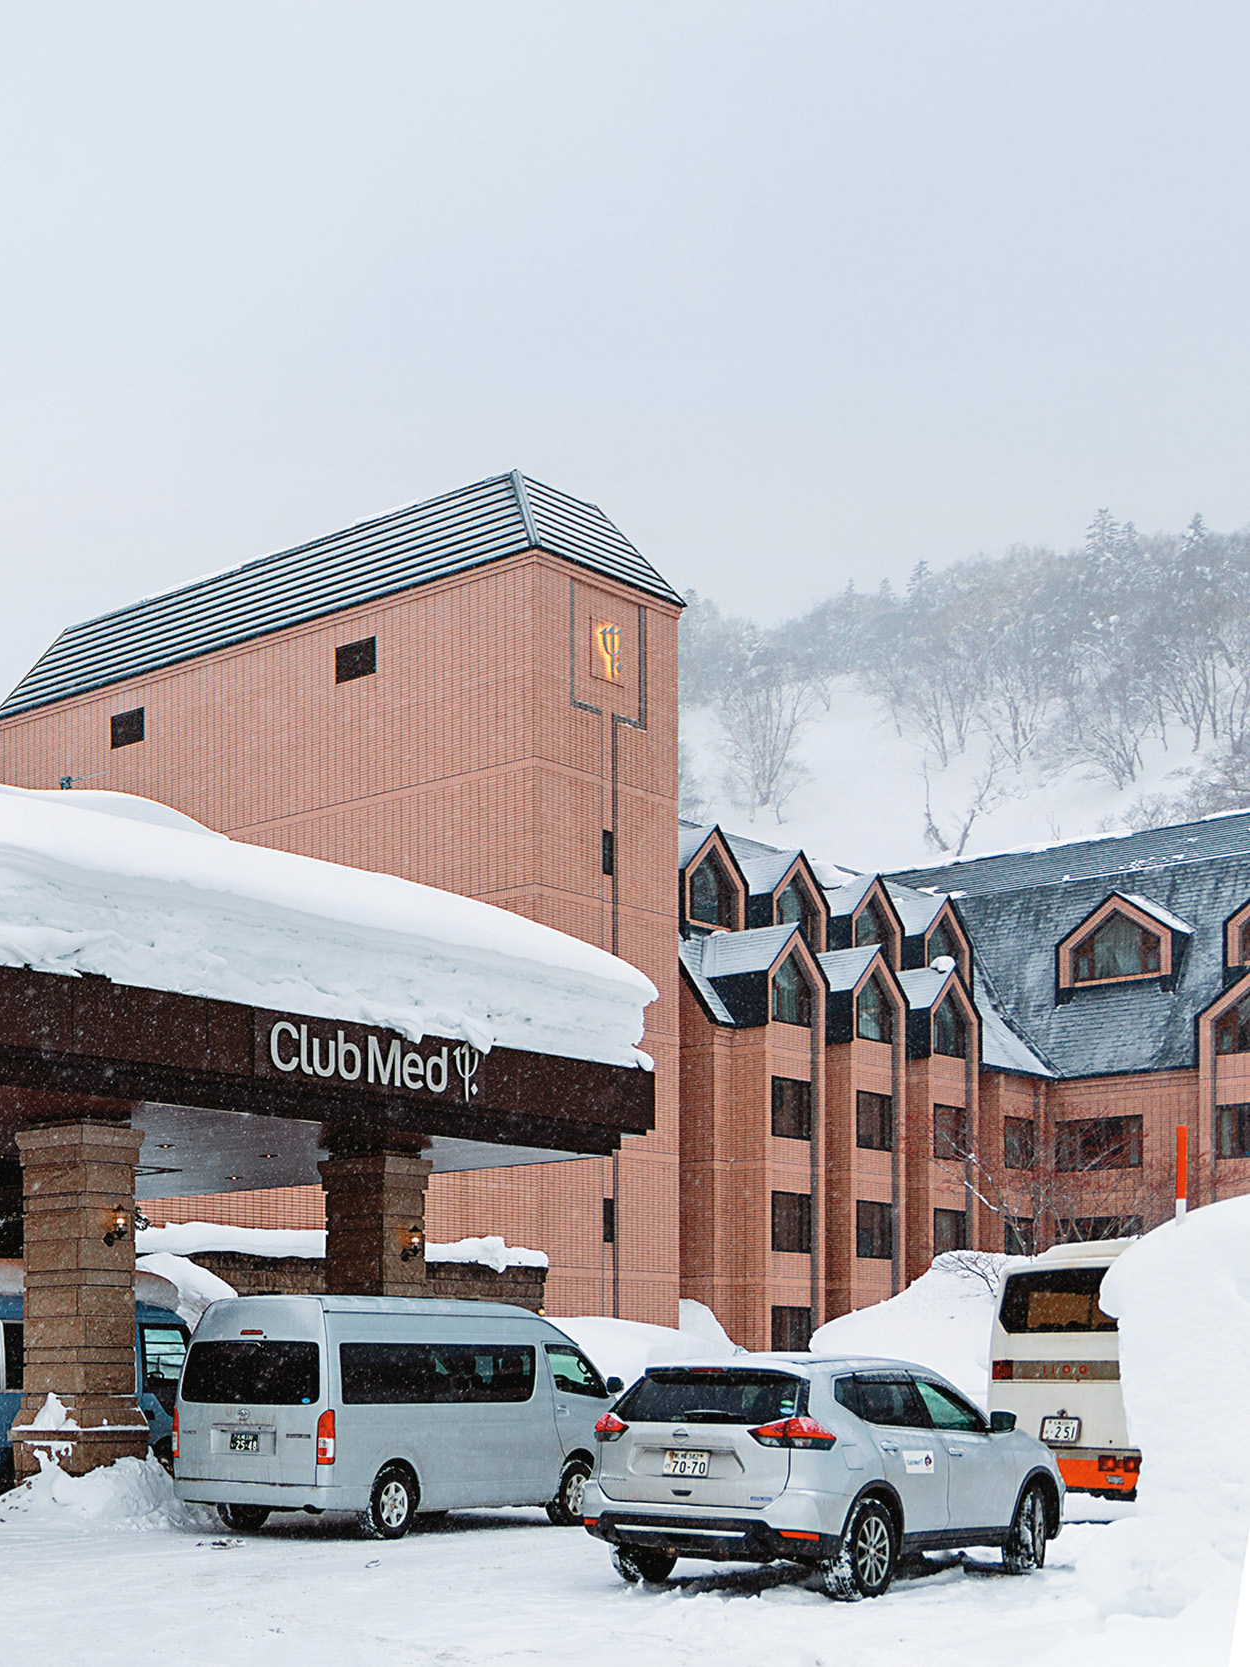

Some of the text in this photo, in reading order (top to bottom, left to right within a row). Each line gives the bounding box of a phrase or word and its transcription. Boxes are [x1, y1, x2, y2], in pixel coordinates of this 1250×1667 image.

[270, 1021, 448, 1093] Club Med
[672, 1461, 706, 1474] 70-70
